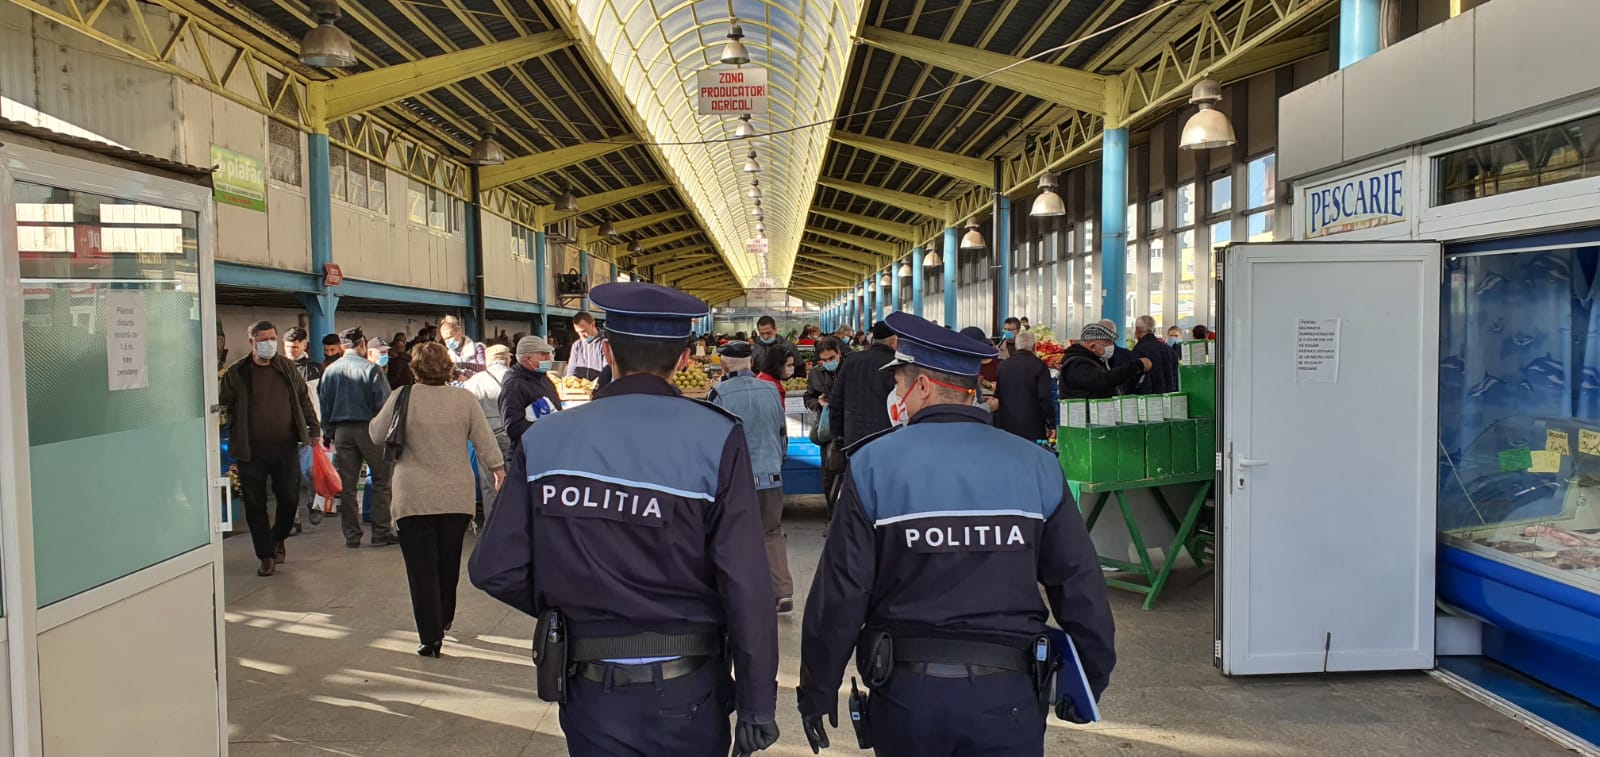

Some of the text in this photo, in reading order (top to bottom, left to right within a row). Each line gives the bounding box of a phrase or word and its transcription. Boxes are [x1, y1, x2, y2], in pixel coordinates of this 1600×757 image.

[719, 72, 744, 84] ZONA
[701, 83, 765, 98] PRODUCATORI
[711, 98, 753, 111] AGRICOLI
[1311, 169, 1403, 233] PESCARIE
[542, 485, 662, 518] POLITIA
[905, 525, 1025, 548] POLITIA
